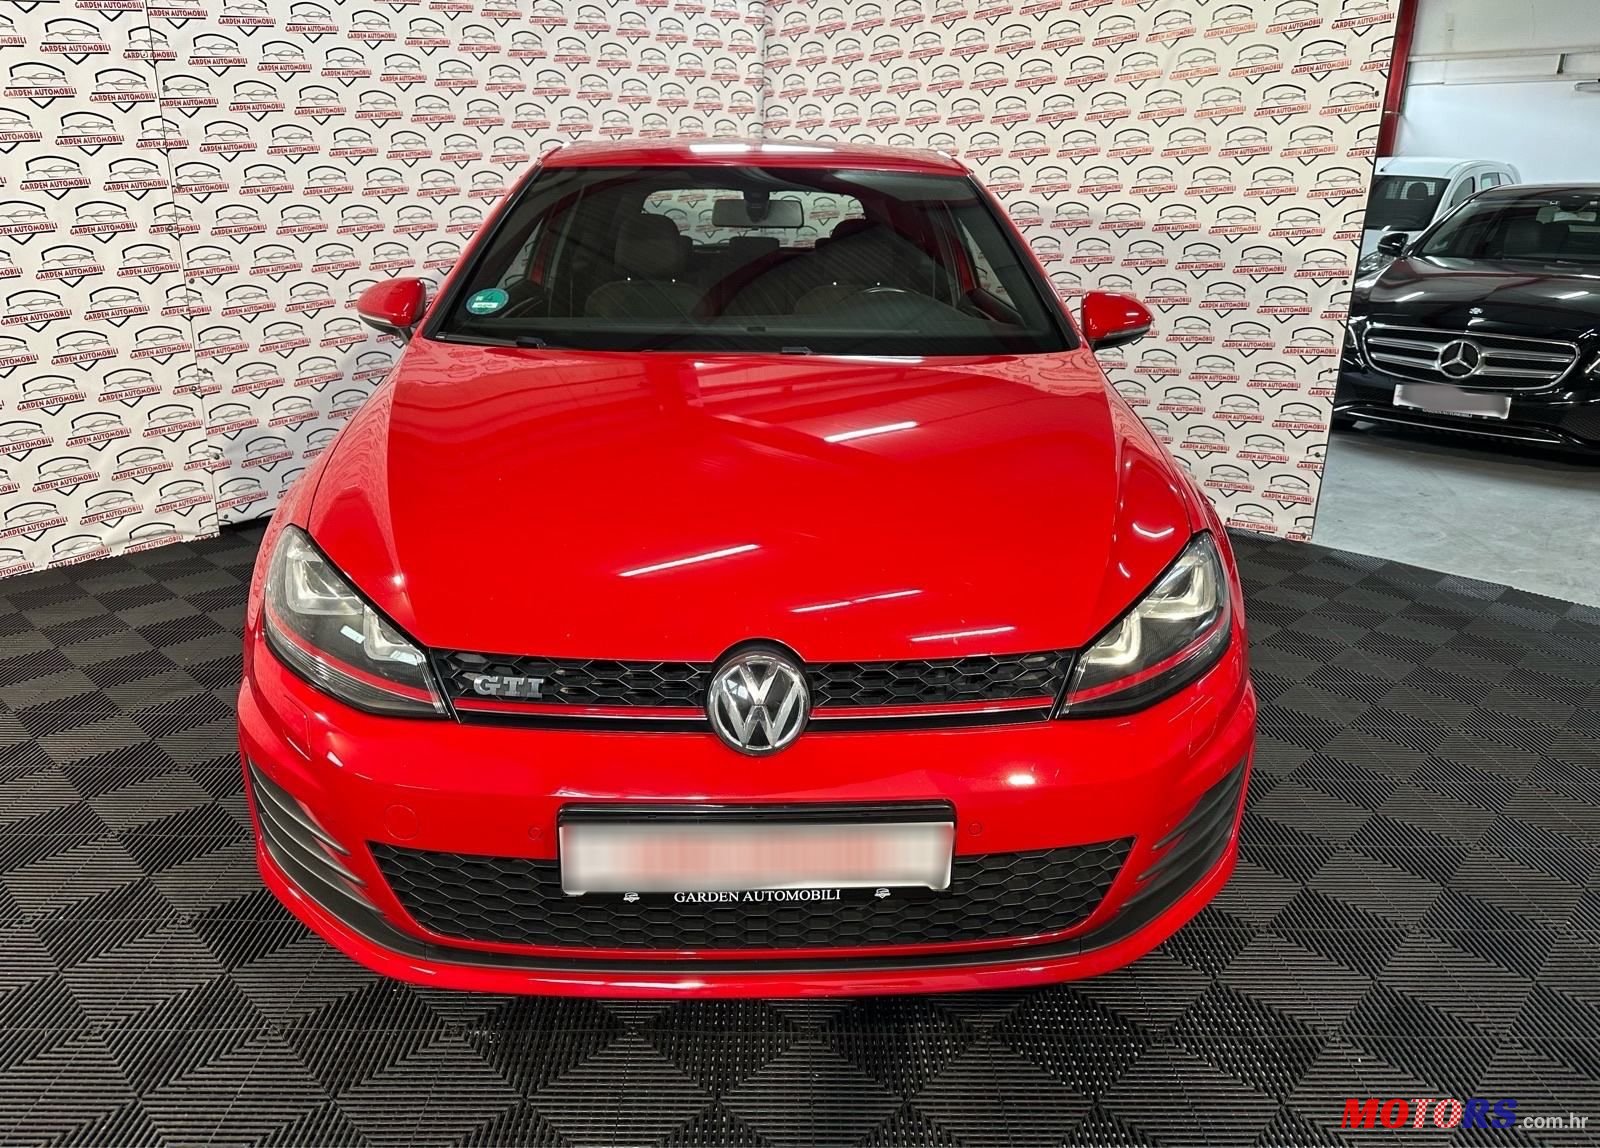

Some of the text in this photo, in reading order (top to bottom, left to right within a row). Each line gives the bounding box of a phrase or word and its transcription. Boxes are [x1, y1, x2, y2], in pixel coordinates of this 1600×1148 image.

[171, 9, 208, 17] AUTOMOBILI
[1265, 18, 1324, 33] GARDEN AUTOMOBILI
[1332, 14, 1394, 29] GARDEN AUTOMOBILI
[69, 44, 111, 52] AUTOMOBILI
[1228, 64, 1283, 76] GARDEN AUTOMOBILI
[1291, 60, 1352, 74] GARDEN AUTOMOBILI
[1360, 63, 1382, 71] GARDEN
[33, 88, 77, 96] AUTOMOBILI
[183, 98, 219, 106] AUTOMOBILI
[1319, 102, 1380, 115] GARDEN AUTOMOBILI
[1254, 104, 1311, 116] GARDEN AUTOMOBILI
[55, 135, 124, 145] GARDEN AUTOMOBILI
[1240, 146, 1273, 154] AUTOMOBILI
[1347, 149, 1369, 157] GARDEN
[20, 178, 91, 190] GARDEN AUTOMOBILI
[103, 180, 169, 191] GARDEN AUTOMOBILI
[194, 183, 229, 192] AUTOMOBILI
[1266, 187, 1299, 195] AUTOMOBILI
[14, 222, 58, 233] AUTOMOBILI
[70, 222, 137, 235] GARDEN AUTOMOBILI
[1291, 228, 1326, 236] AUTOMOBILI
[36, 265, 105, 280] GARDEN AUTOMOBILI
[117, 263, 181, 277] GARDEN AUTOMOBILI
[205, 264, 240, 276] AUTOMOBILI
[1, 309, 72, 325] GARDEN AUTOMOBILI
[84, 306, 150, 320] GARDEN AUTOMOBILI
[51, 348, 119, 365] GARDEN AUTOMOBILI
[130, 343, 192, 358] GARDEN AUTOMOBILI
[98, 385, 162, 402] GARDEN AUTOMOBILI
[17, 392, 87, 410] GARDEN AUTOMOBILI
[143, 421, 203, 437] GARDEN AUTOMOBILI
[12, 437, 54, 451] AUTOMOBILI
[66, 428, 131, 447] GARDEN AUTOMOBILI
[111, 462, 173, 481] GARDEN AUTOMOBILI
[32, 473, 100, 492] GARDEN AUTOMOBILI
[155, 494, 213, 513] GARDEN AUTOMOBILI
[80, 505, 143, 525] GARDEN AUTOMOBILI
[27, 516, 68, 532] AUTOMOBILI
[473, 675, 545, 699] GTI
[674, 890, 841, 902] GARDEN AUTOMOBILI
